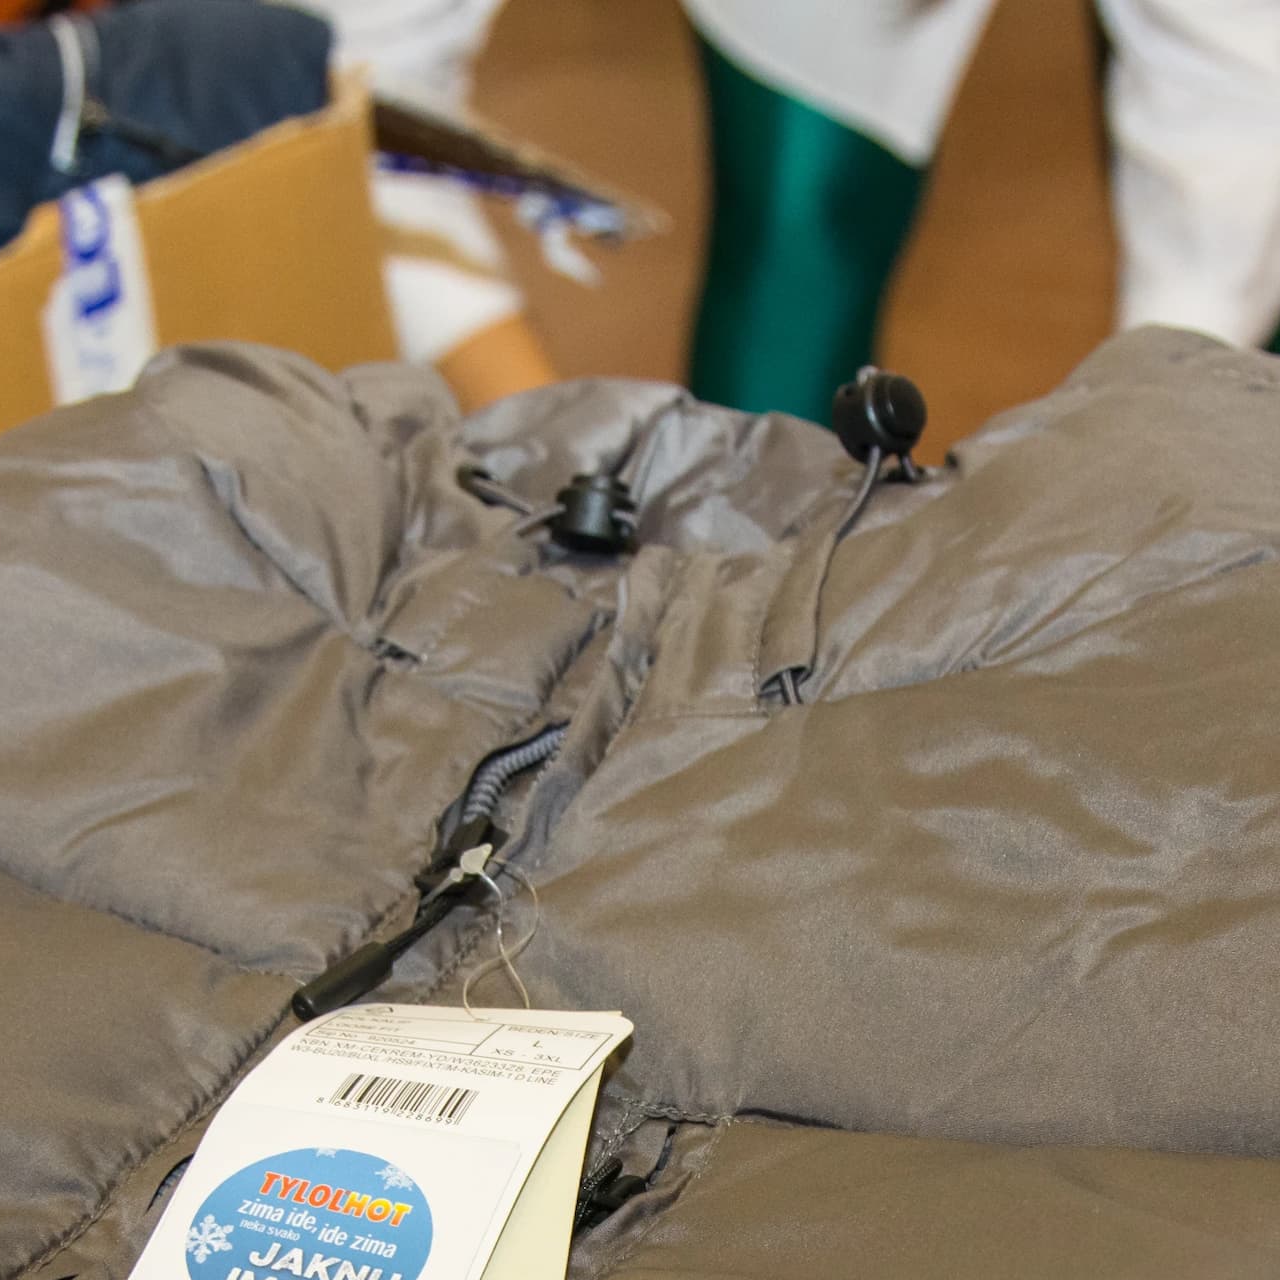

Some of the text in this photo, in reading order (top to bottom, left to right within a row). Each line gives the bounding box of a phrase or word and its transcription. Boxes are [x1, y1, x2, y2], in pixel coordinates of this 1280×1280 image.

[532, 1040, 544, 1049] L
[237, 1198, 398, 1259] zima ide, ide zima
[239, 1218, 301, 1242] neka svako
